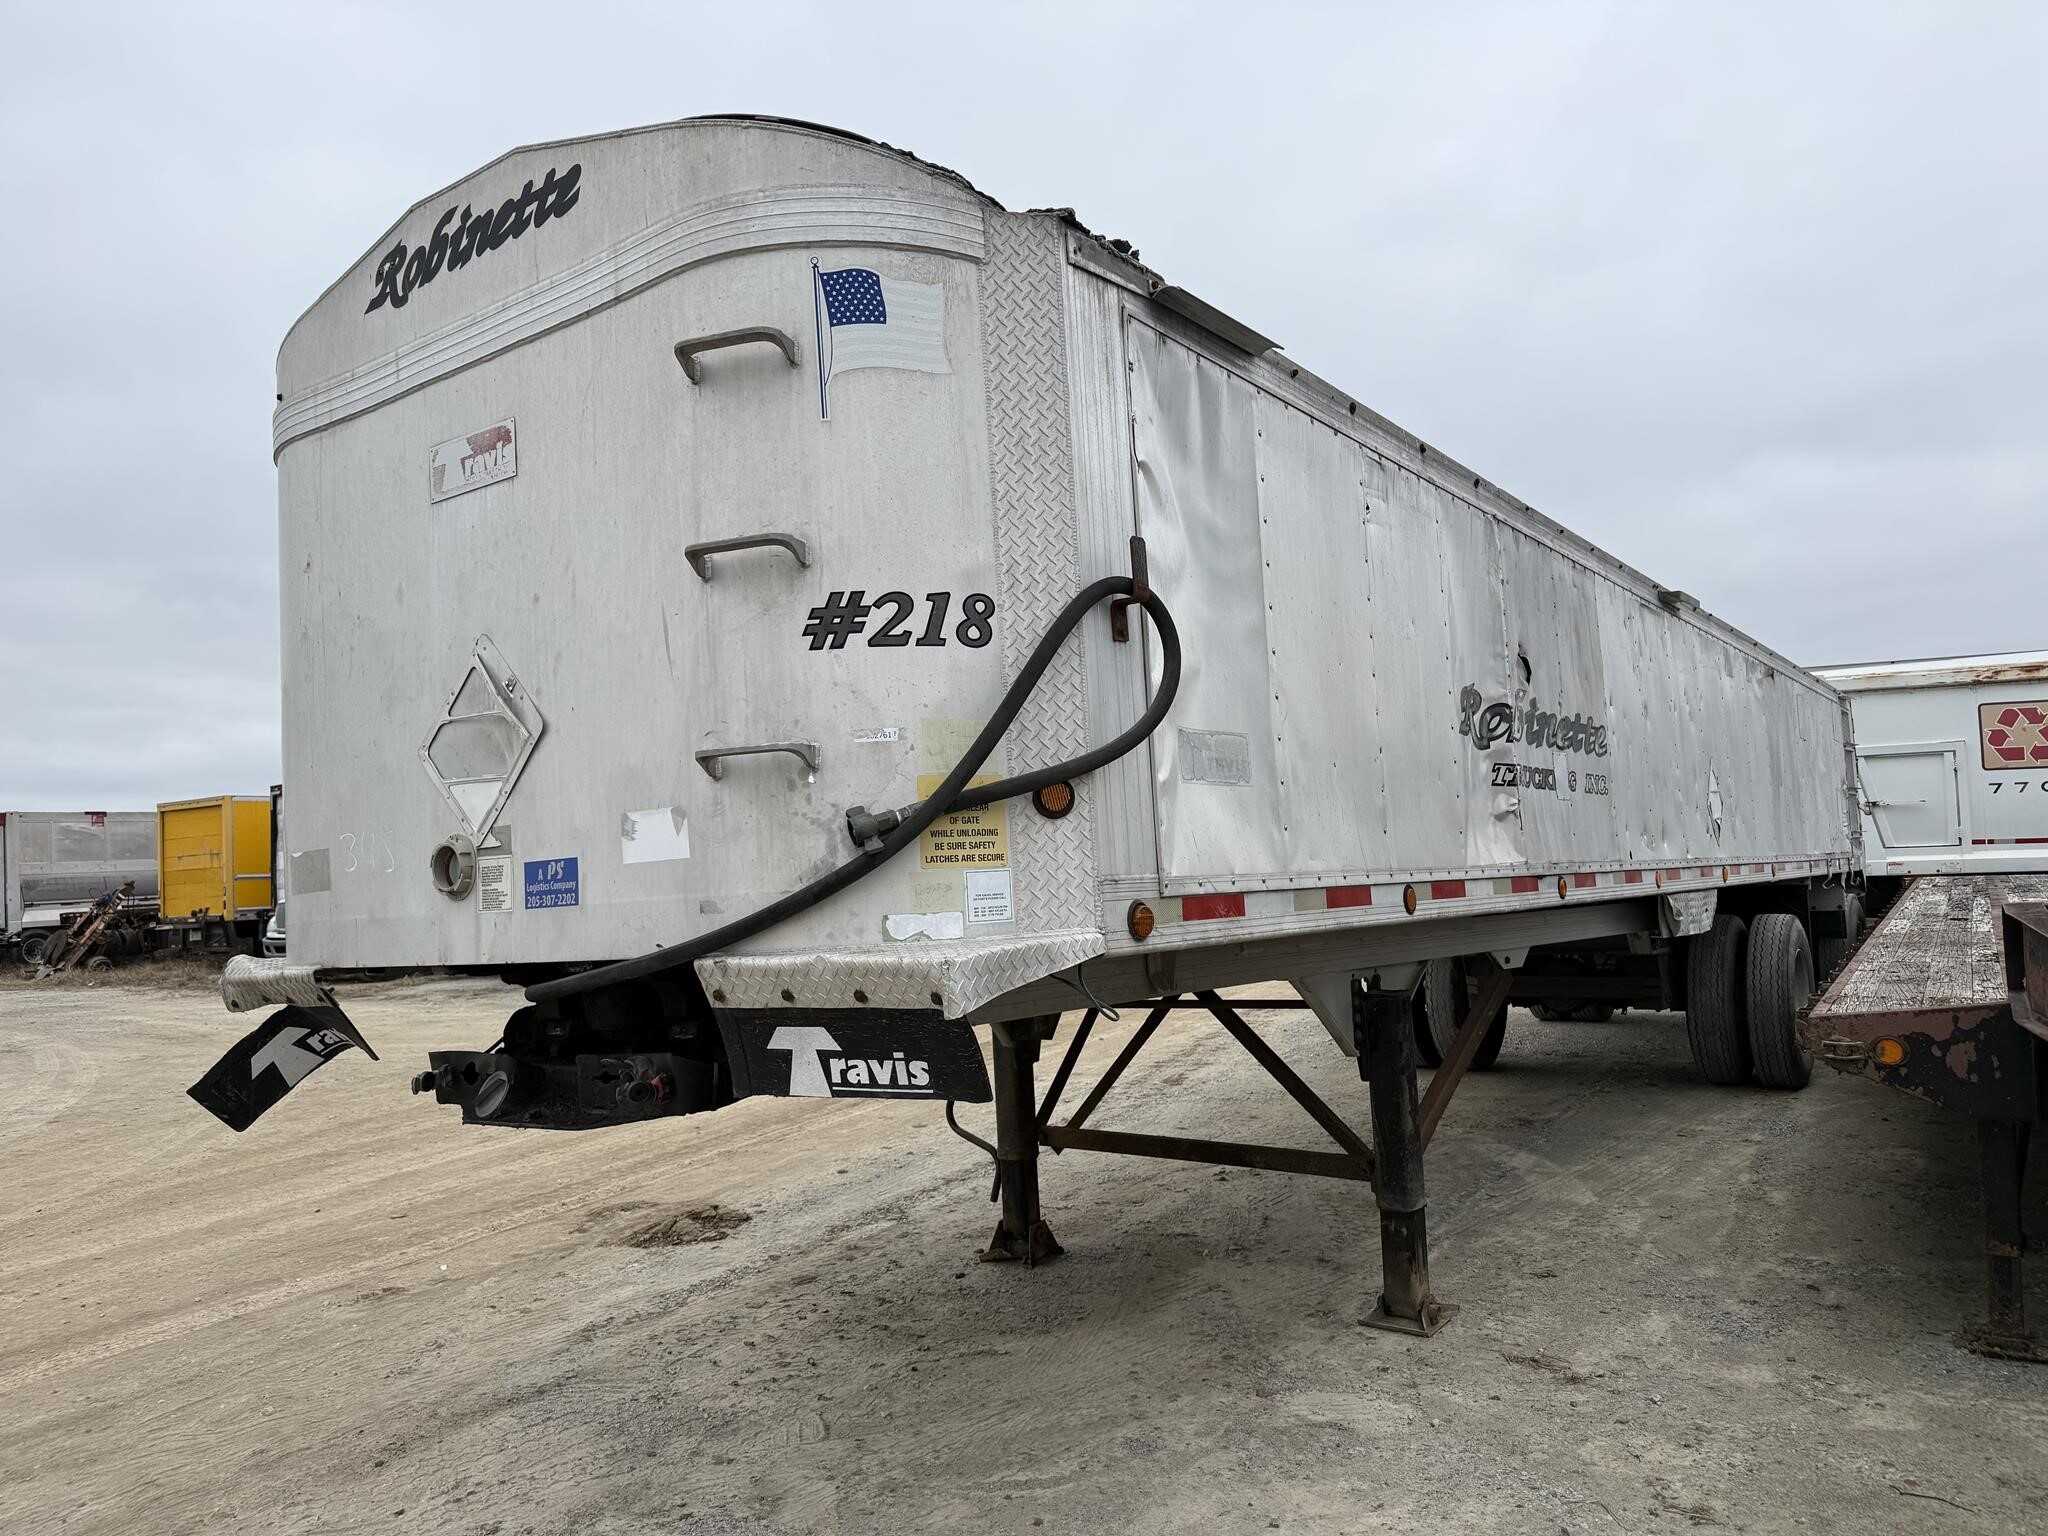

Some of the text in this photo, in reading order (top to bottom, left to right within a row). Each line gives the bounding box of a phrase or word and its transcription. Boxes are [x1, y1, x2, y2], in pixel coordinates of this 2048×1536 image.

[364, 163, 582, 315] Robinette
[802, 590, 996, 650] #218
[1491, 762, 1577, 793] TRUCKIG
[949, 815, 980, 825] OF GATE
[930, 828, 999, 838] WHILE UNLOADING
[934, 841, 996, 851] BE SURE SAFETY
[925, 853, 1005, 864] LATCHES ARE SECURE
[526, 880, 577, 894] Logistics Company
[527, 893, 576, 907] 205-307-2202
[766, 1026, 931, 1097] Travis
